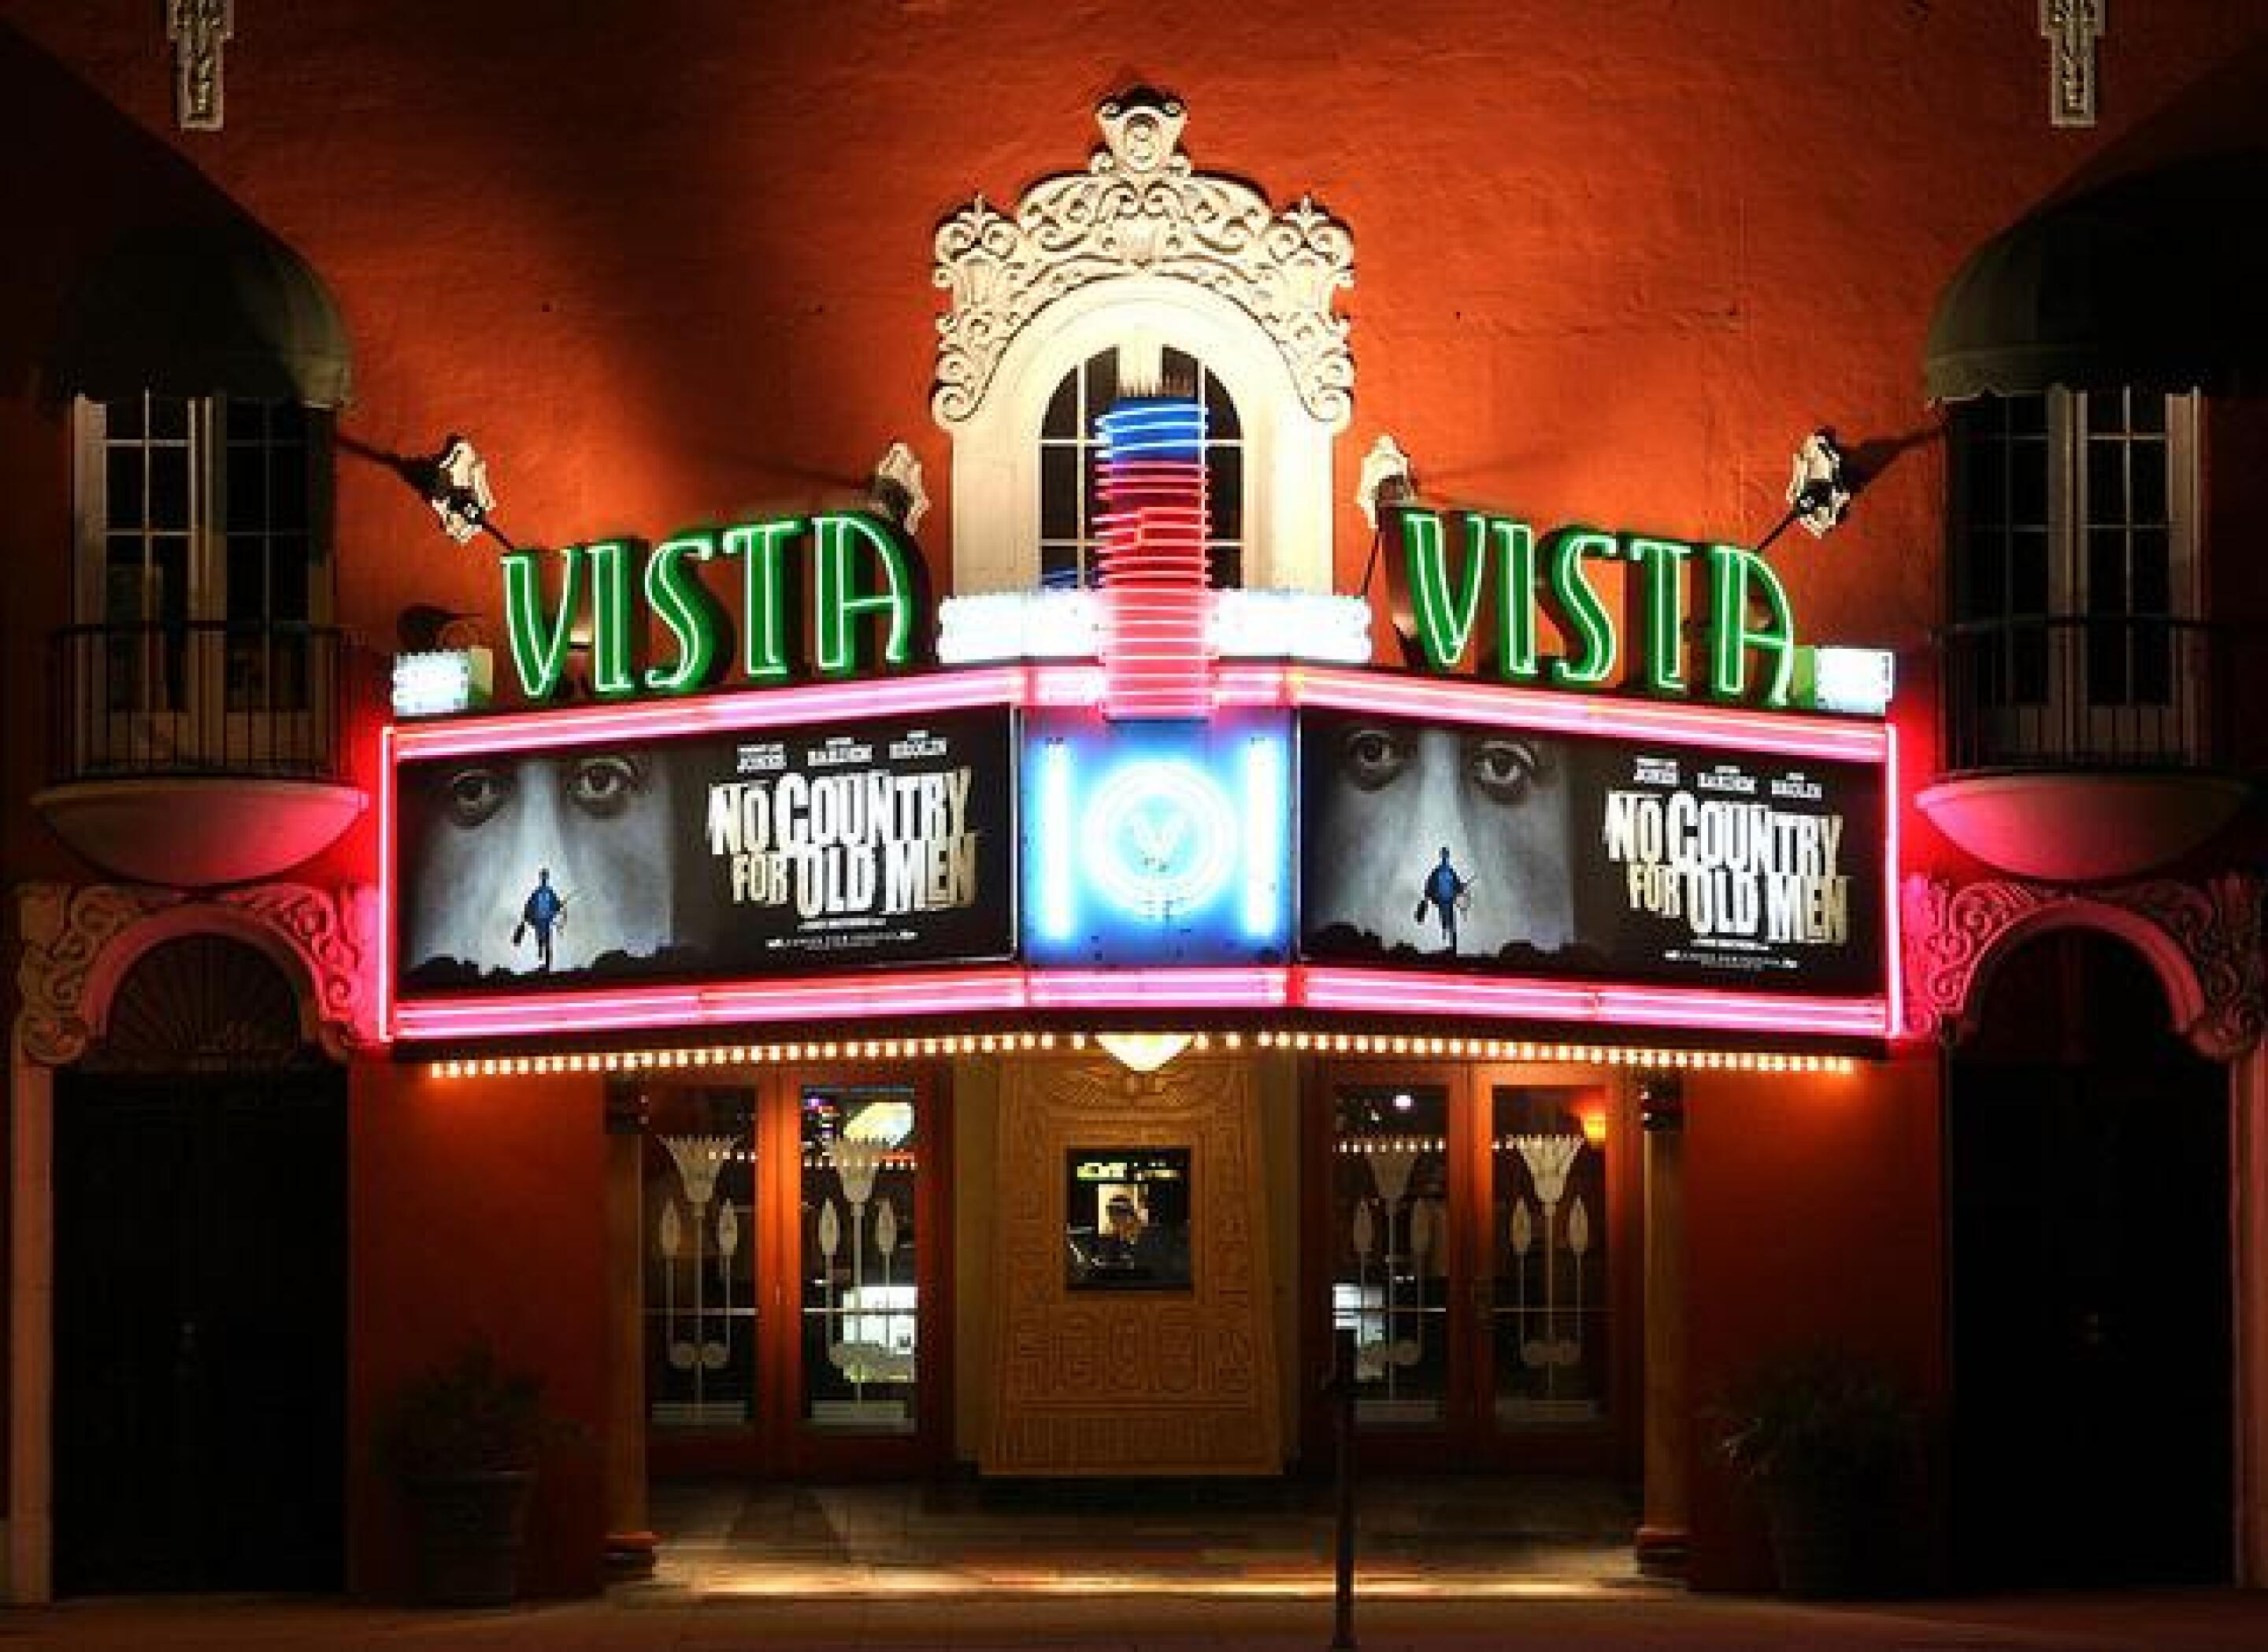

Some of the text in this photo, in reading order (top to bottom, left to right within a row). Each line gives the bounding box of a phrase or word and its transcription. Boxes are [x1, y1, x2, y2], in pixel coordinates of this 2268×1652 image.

[500, 510, 917, 699] VISTA
[1399, 509, 1796, 707] VISTA
[706, 769, 973, 856] NO COUNTRY
[1603, 790, 1844, 877] NO COUNTRY
[731, 833, 976, 918] FOR OLD MEN
[1627, 862, 1851, 944] FOR OLD MEN
